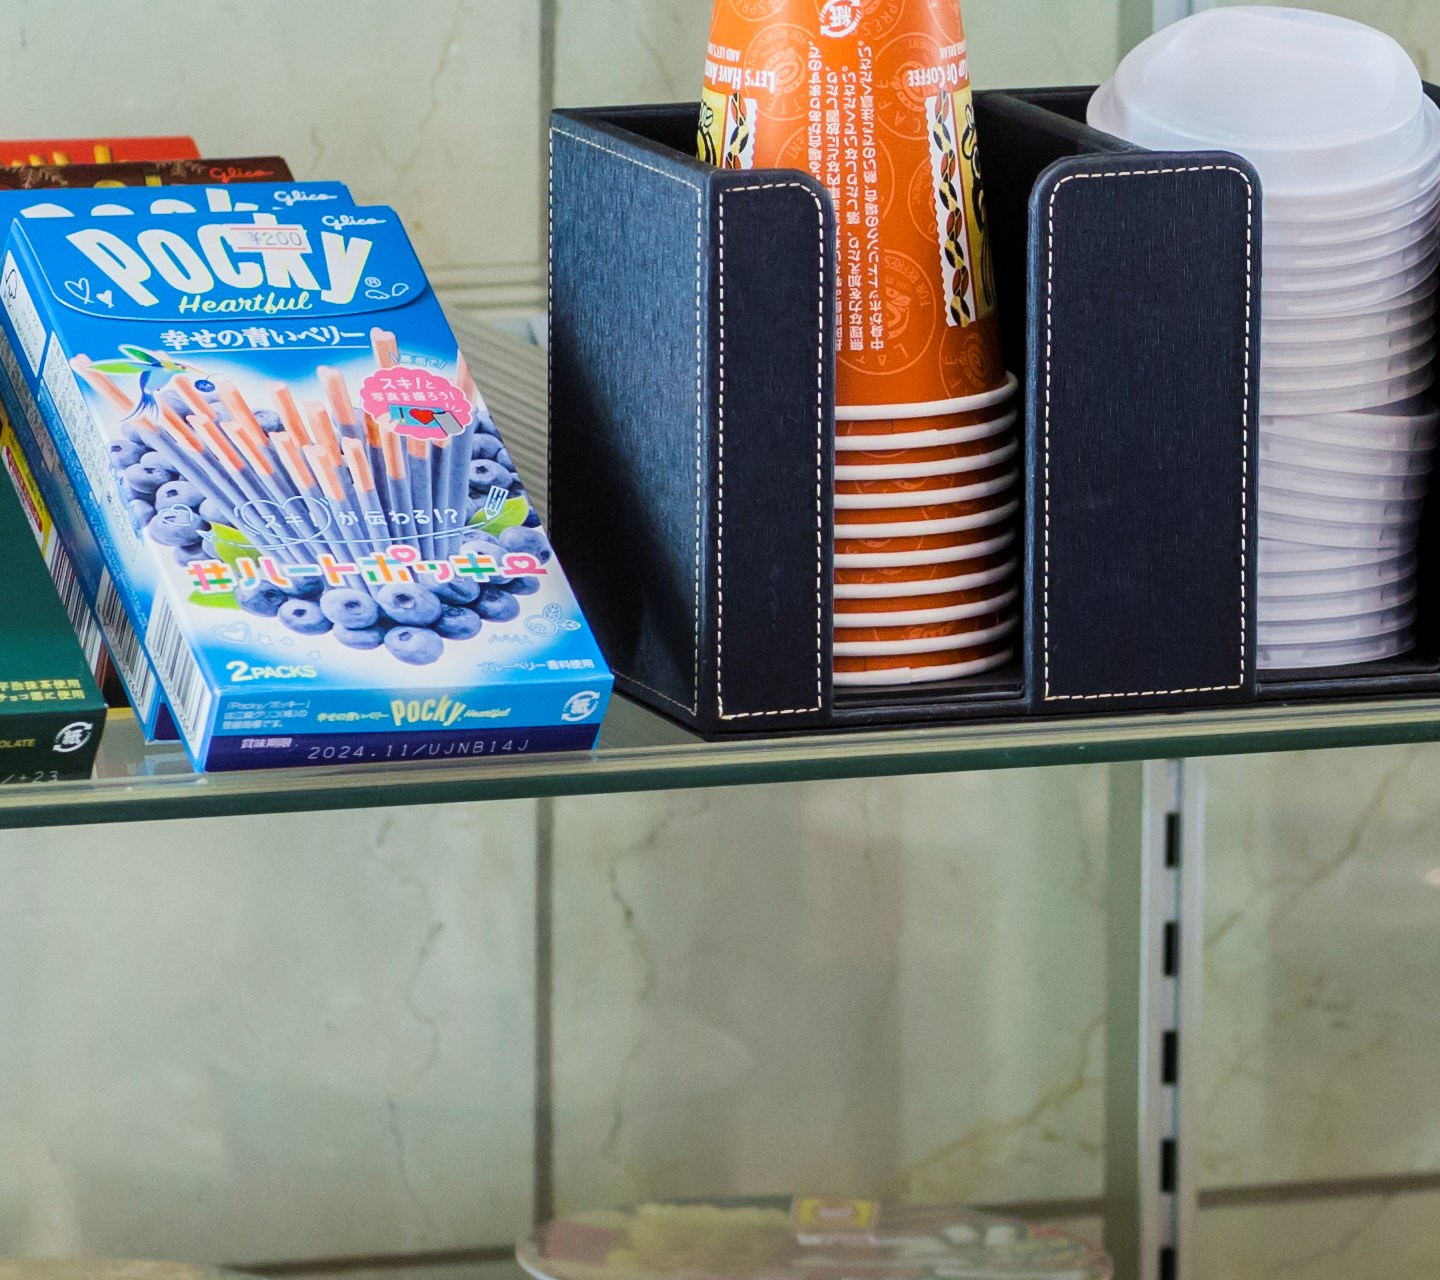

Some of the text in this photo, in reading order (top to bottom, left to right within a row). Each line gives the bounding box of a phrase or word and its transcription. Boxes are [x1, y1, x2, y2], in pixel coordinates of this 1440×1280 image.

[248, 228, 305, 249] ¥200
[177, 289, 314, 315] Heartful
[160, 326, 366, 351] 幸せの青いベリー
